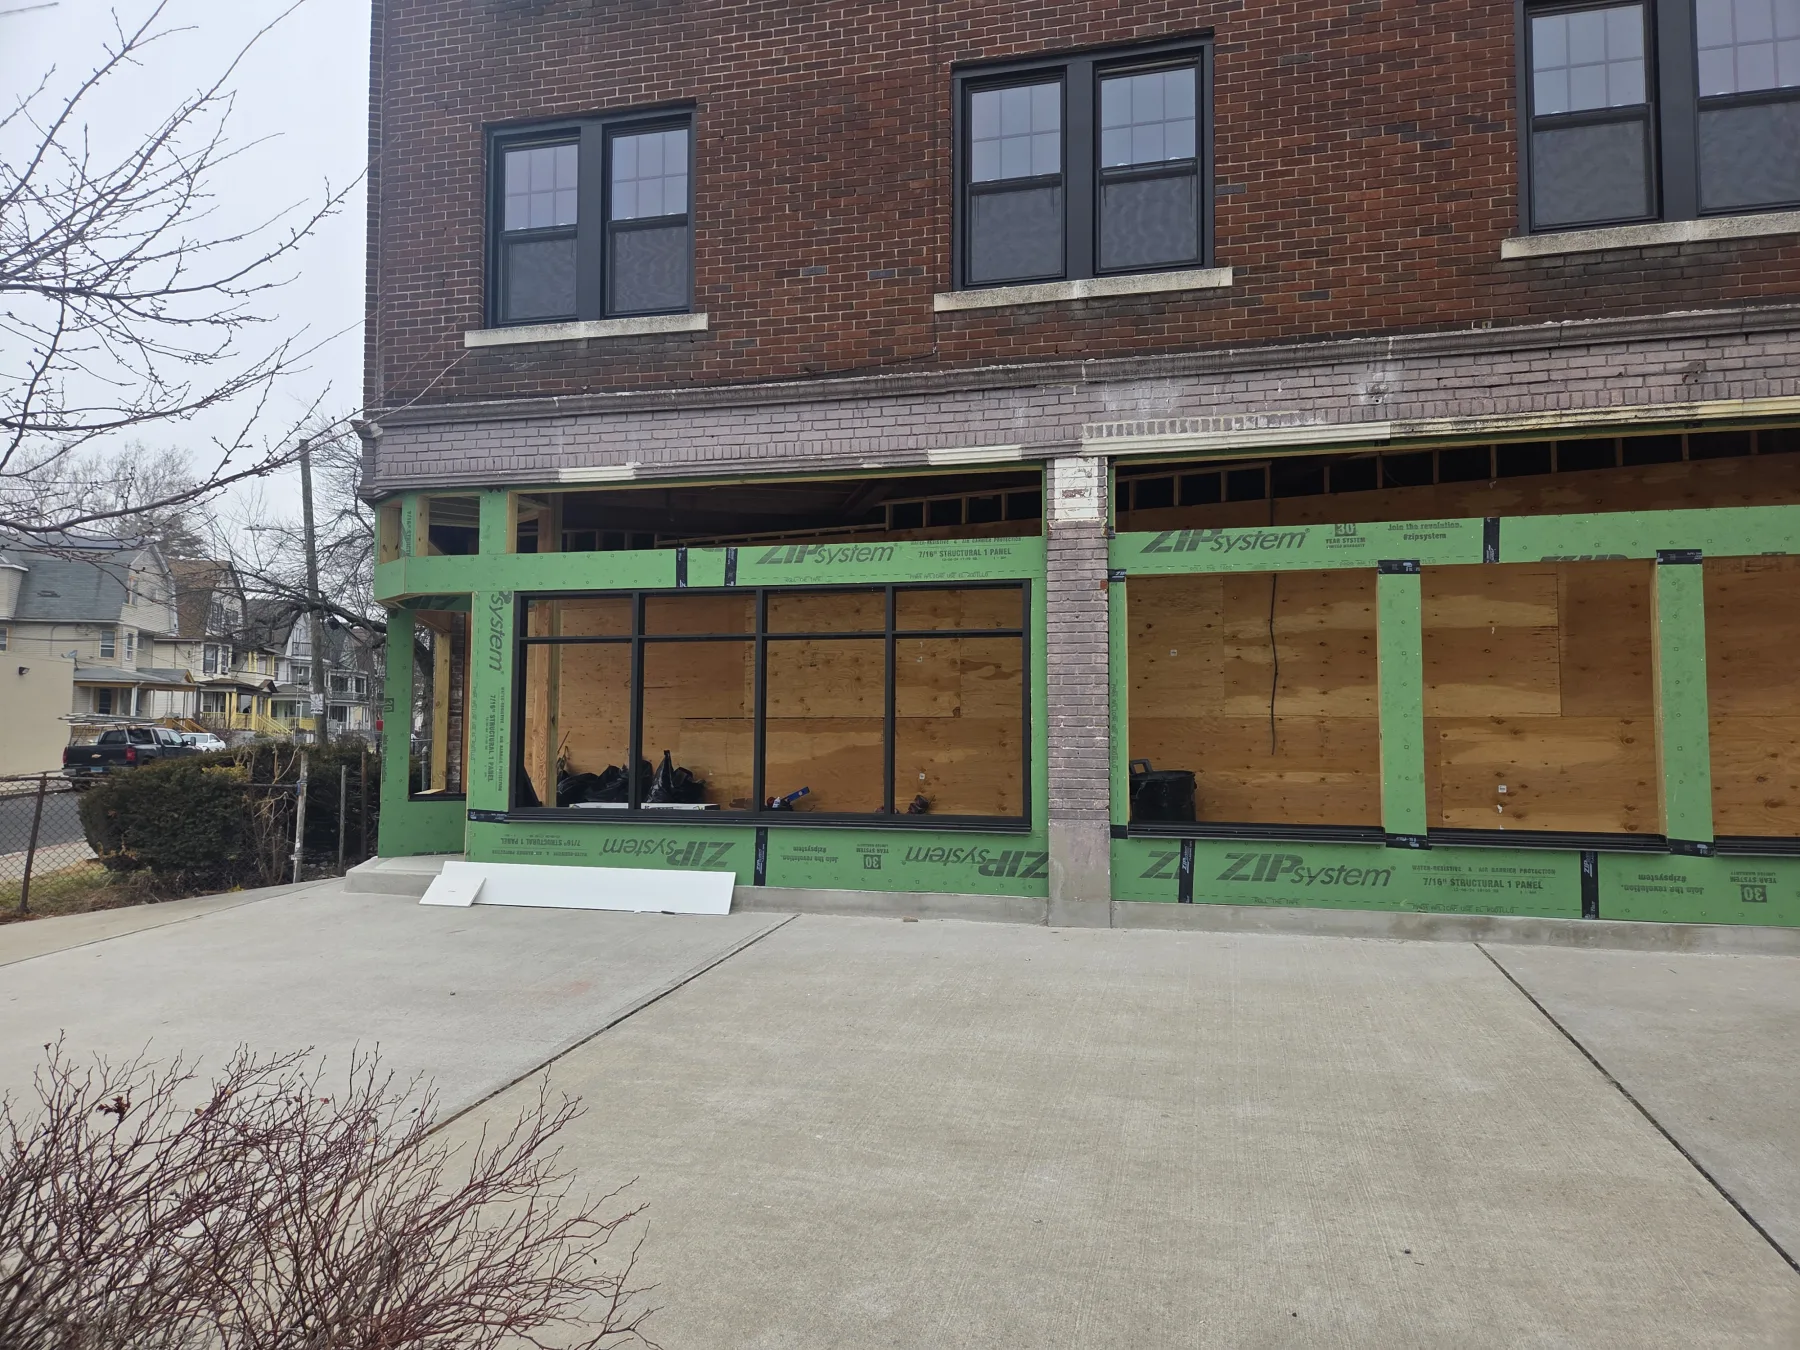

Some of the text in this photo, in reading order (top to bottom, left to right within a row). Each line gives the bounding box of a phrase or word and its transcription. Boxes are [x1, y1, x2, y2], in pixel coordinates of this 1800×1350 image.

[1336, 523, 1355, 535] 30
[1388, 523, 1404, 531] Join
[939, 549, 982, 557] STRUCTURAL
[989, 547, 1012, 555] PANEL
[526, 838, 562, 846] STRUCTURAL
[865, 855, 880, 869] 30
[1450, 878, 1504, 888] STRUCTURAL
[1507, 880, 1512, 888] 1
[1515, 880, 1544, 889] PANEL
[1669, 885, 1684, 894] the
[1686, 886, 1704, 895] Join
[1742, 886, 1765, 902] 30
